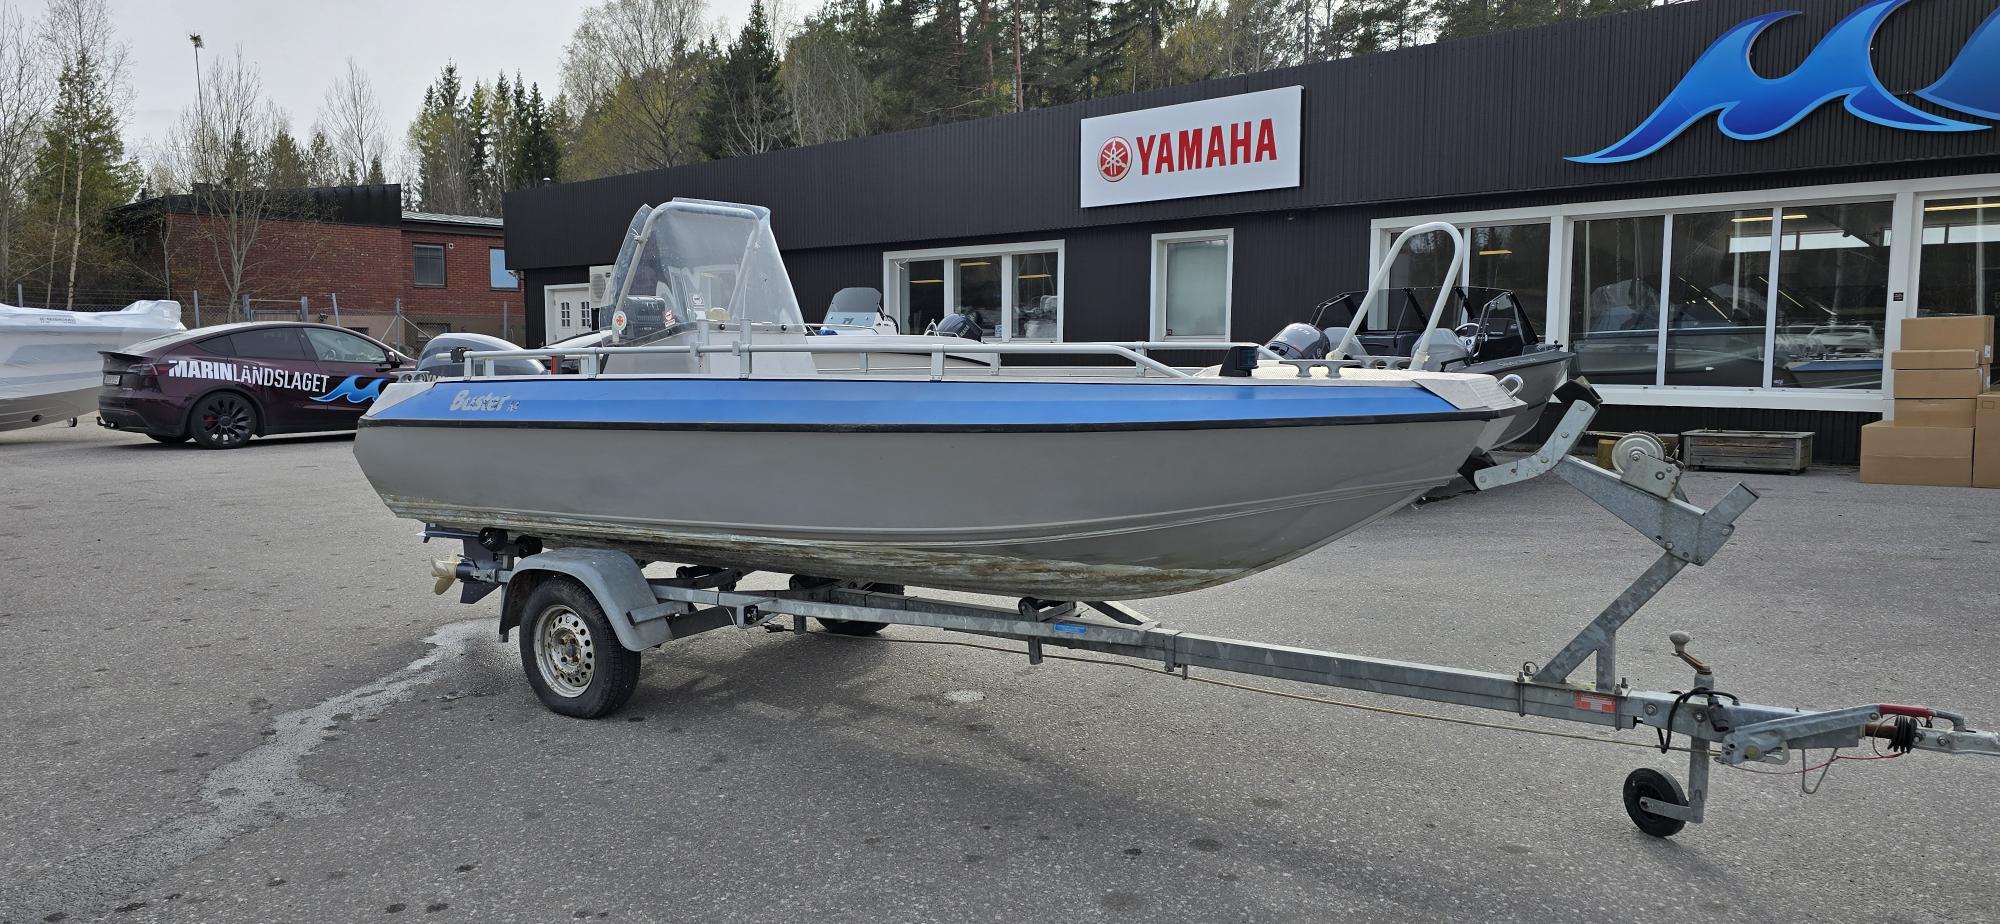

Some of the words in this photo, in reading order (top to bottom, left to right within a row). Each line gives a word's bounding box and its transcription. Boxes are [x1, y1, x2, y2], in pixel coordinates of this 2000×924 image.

[1136, 118, 1277, 176] YAMAHA
[168, 359, 329, 393] MARINLANDSLAGET
[449, 389, 512, 411] Buster
